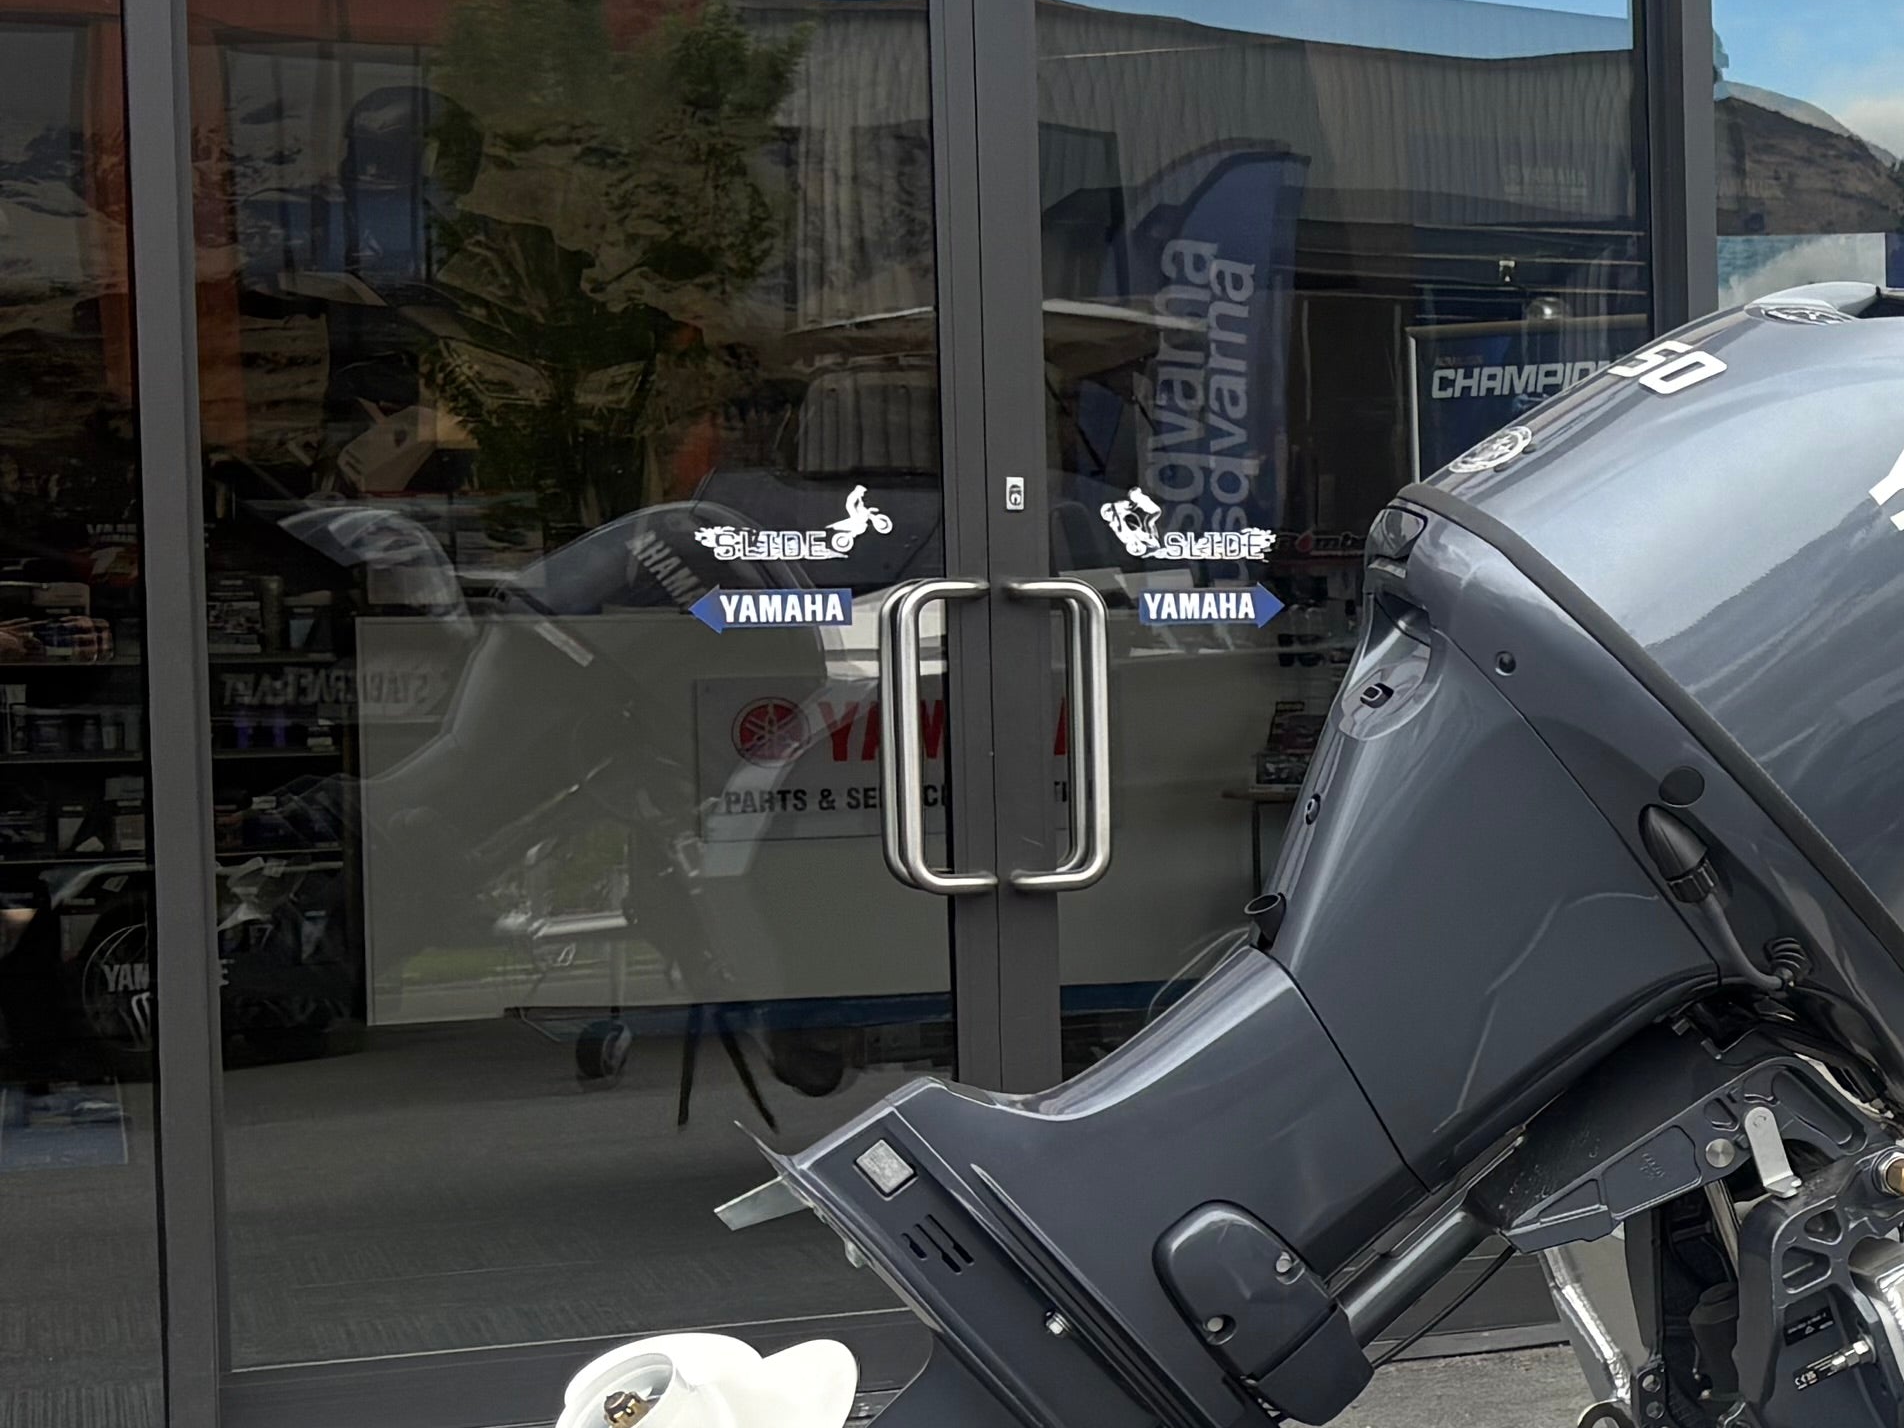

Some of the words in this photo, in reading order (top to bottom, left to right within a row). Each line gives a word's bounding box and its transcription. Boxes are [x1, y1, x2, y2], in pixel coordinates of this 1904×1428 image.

[1607, 340, 1728, 396] 50
[713, 529, 829, 561] SLIDE
[1163, 530, 1266, 560] SLIDE
[719, 592, 846, 624] YAMAHA
[1143, 592, 1256, 621] YAMAHA
[723, 787, 808, 814] PARTS
[818, 787, 836, 811] &
